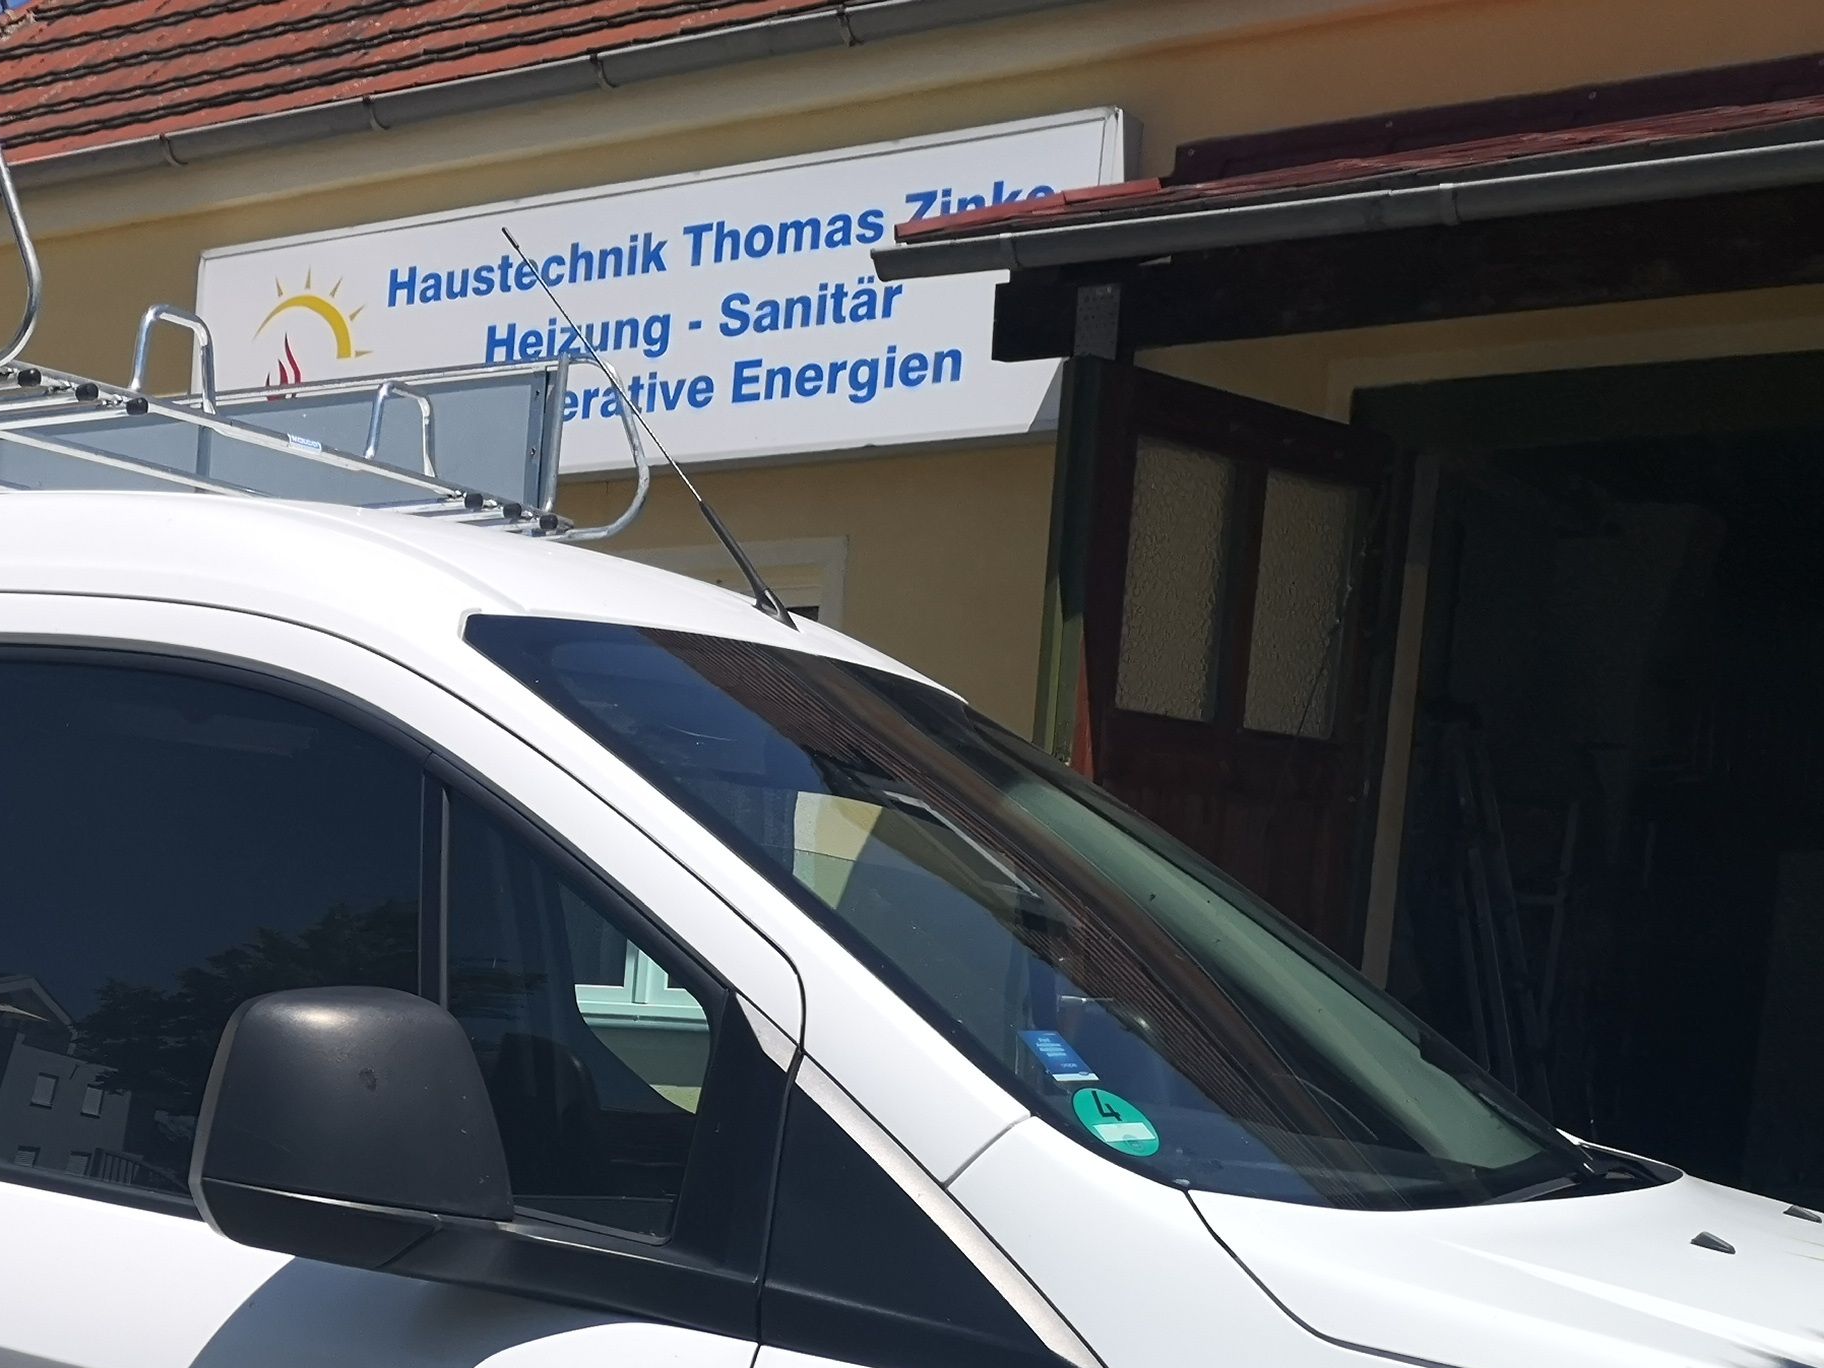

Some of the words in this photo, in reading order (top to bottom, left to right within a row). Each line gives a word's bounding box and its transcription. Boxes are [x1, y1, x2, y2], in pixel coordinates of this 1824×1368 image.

[387, 232, 668, 308] Haustechnik
[682, 208, 886, 267] Thomas
[484, 313, 672, 366] Heizung
[717, 281, 904, 338] Sanitär
[730, 344, 963, 406] Energien
